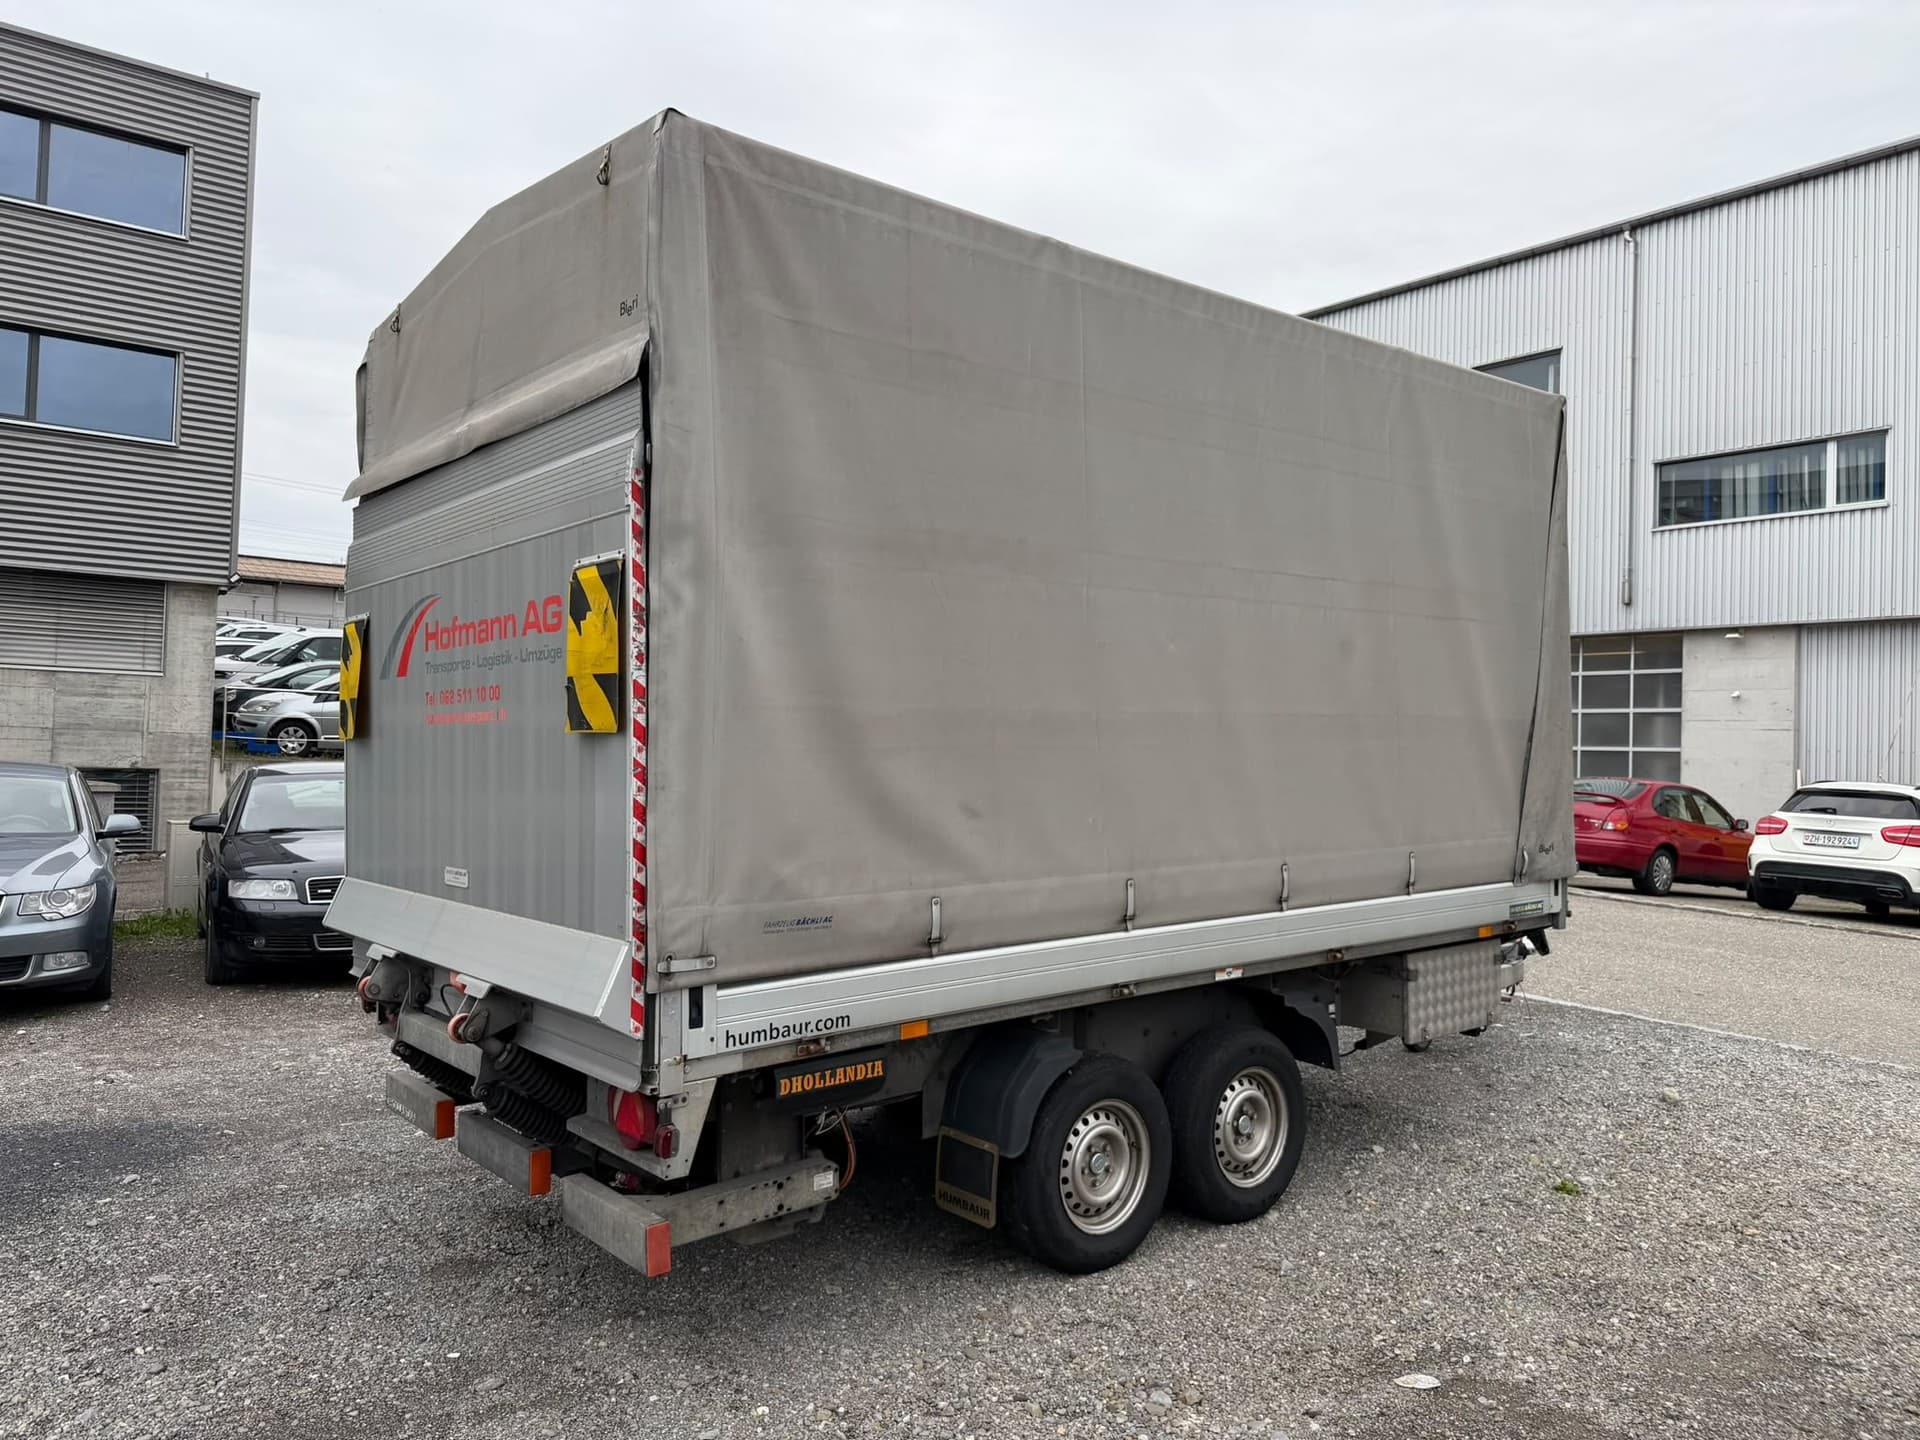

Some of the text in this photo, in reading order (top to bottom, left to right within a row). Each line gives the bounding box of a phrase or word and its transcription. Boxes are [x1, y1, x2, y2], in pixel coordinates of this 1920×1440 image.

[619, 293, 639, 317] Bieri
[424, 594, 564, 653] Hofmann AG
[425, 657, 471, 675] Transporte
[476, 649, 513, 671] Logistik
[520, 644, 563, 664] Umzüge
[457, 686, 472, 704] 511
[476, 684, 487, 703] 10
[489, 684, 501, 702] 00
[725, 1014, 851, 1048] humbaur.com
[779, 1060, 884, 1096] DHOLLANDIA
[938, 1188, 991, 1221] HUMBAUR
